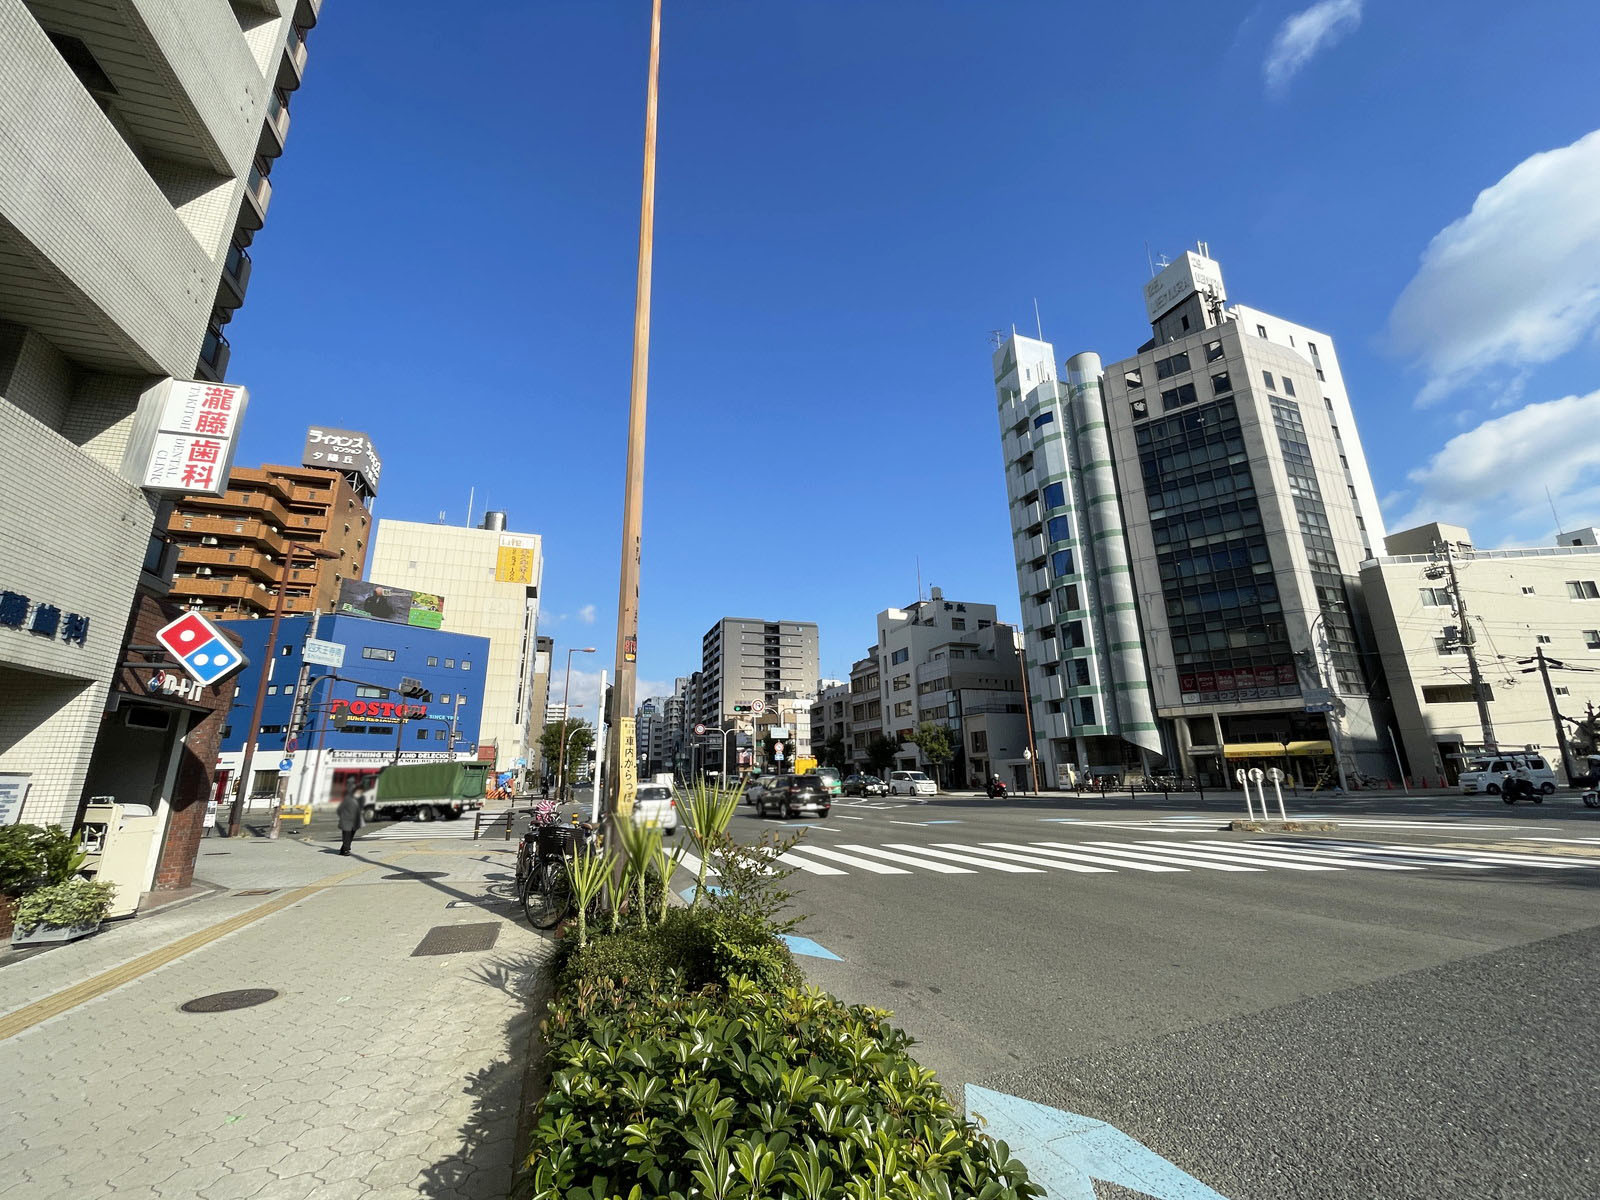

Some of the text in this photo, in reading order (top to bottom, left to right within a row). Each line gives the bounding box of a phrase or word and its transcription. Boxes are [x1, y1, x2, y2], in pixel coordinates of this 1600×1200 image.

[309, 429, 363, 447] ライオンズ
[333, 751, 382, 759] SOMETHING
